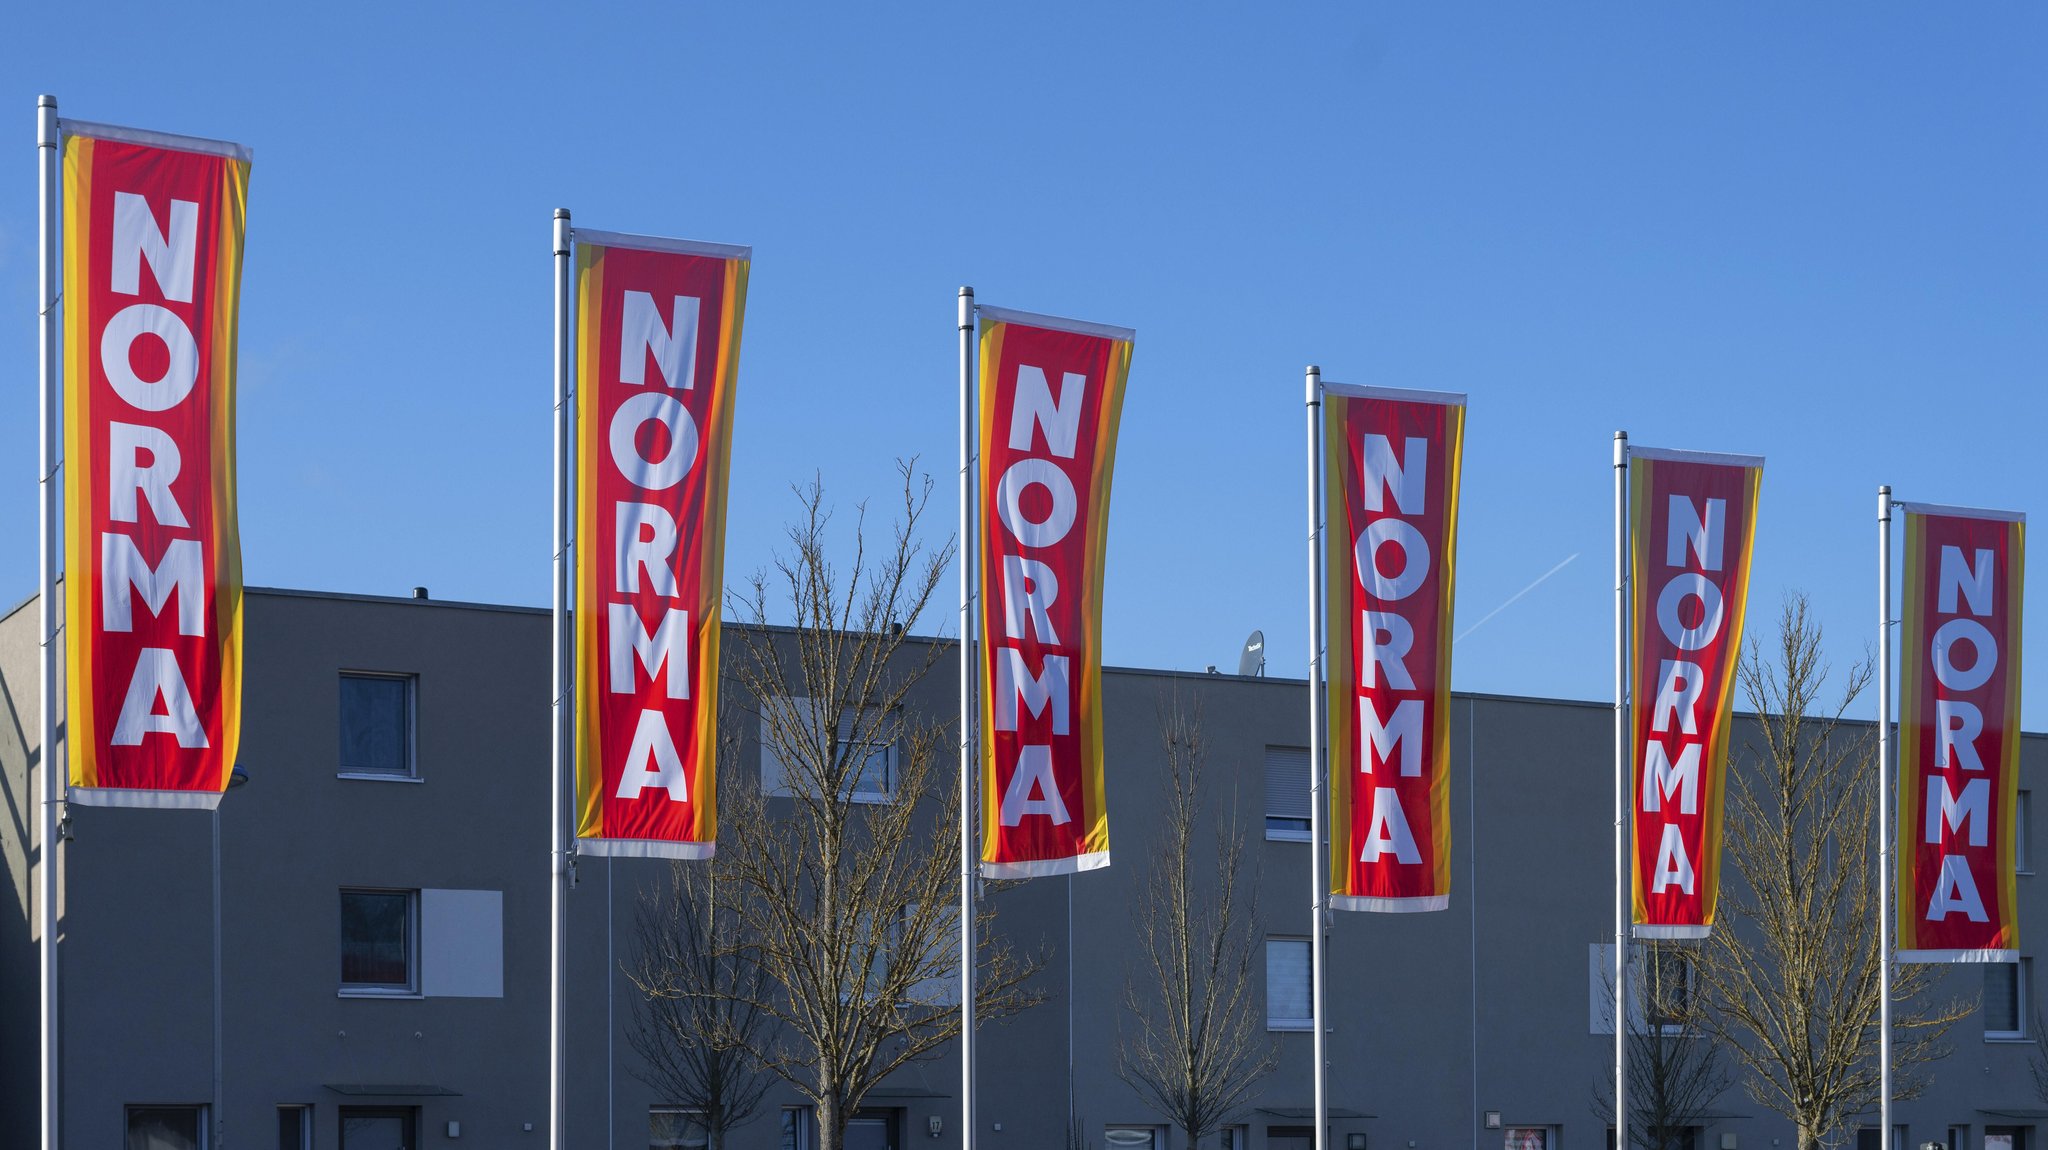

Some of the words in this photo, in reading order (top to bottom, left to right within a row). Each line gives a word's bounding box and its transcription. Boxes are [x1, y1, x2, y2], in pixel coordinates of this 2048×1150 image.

[101, 191, 208, 748] NORMA
[608, 290, 700, 801] NORMA
[996, 364, 1086, 826] NORMA
[1355, 434, 1429, 864] NORMA
[1643, 494, 1727, 894] NORMA
[1926, 546, 1997, 922] NORMA
[932, 1121, 940, 1130] 17
